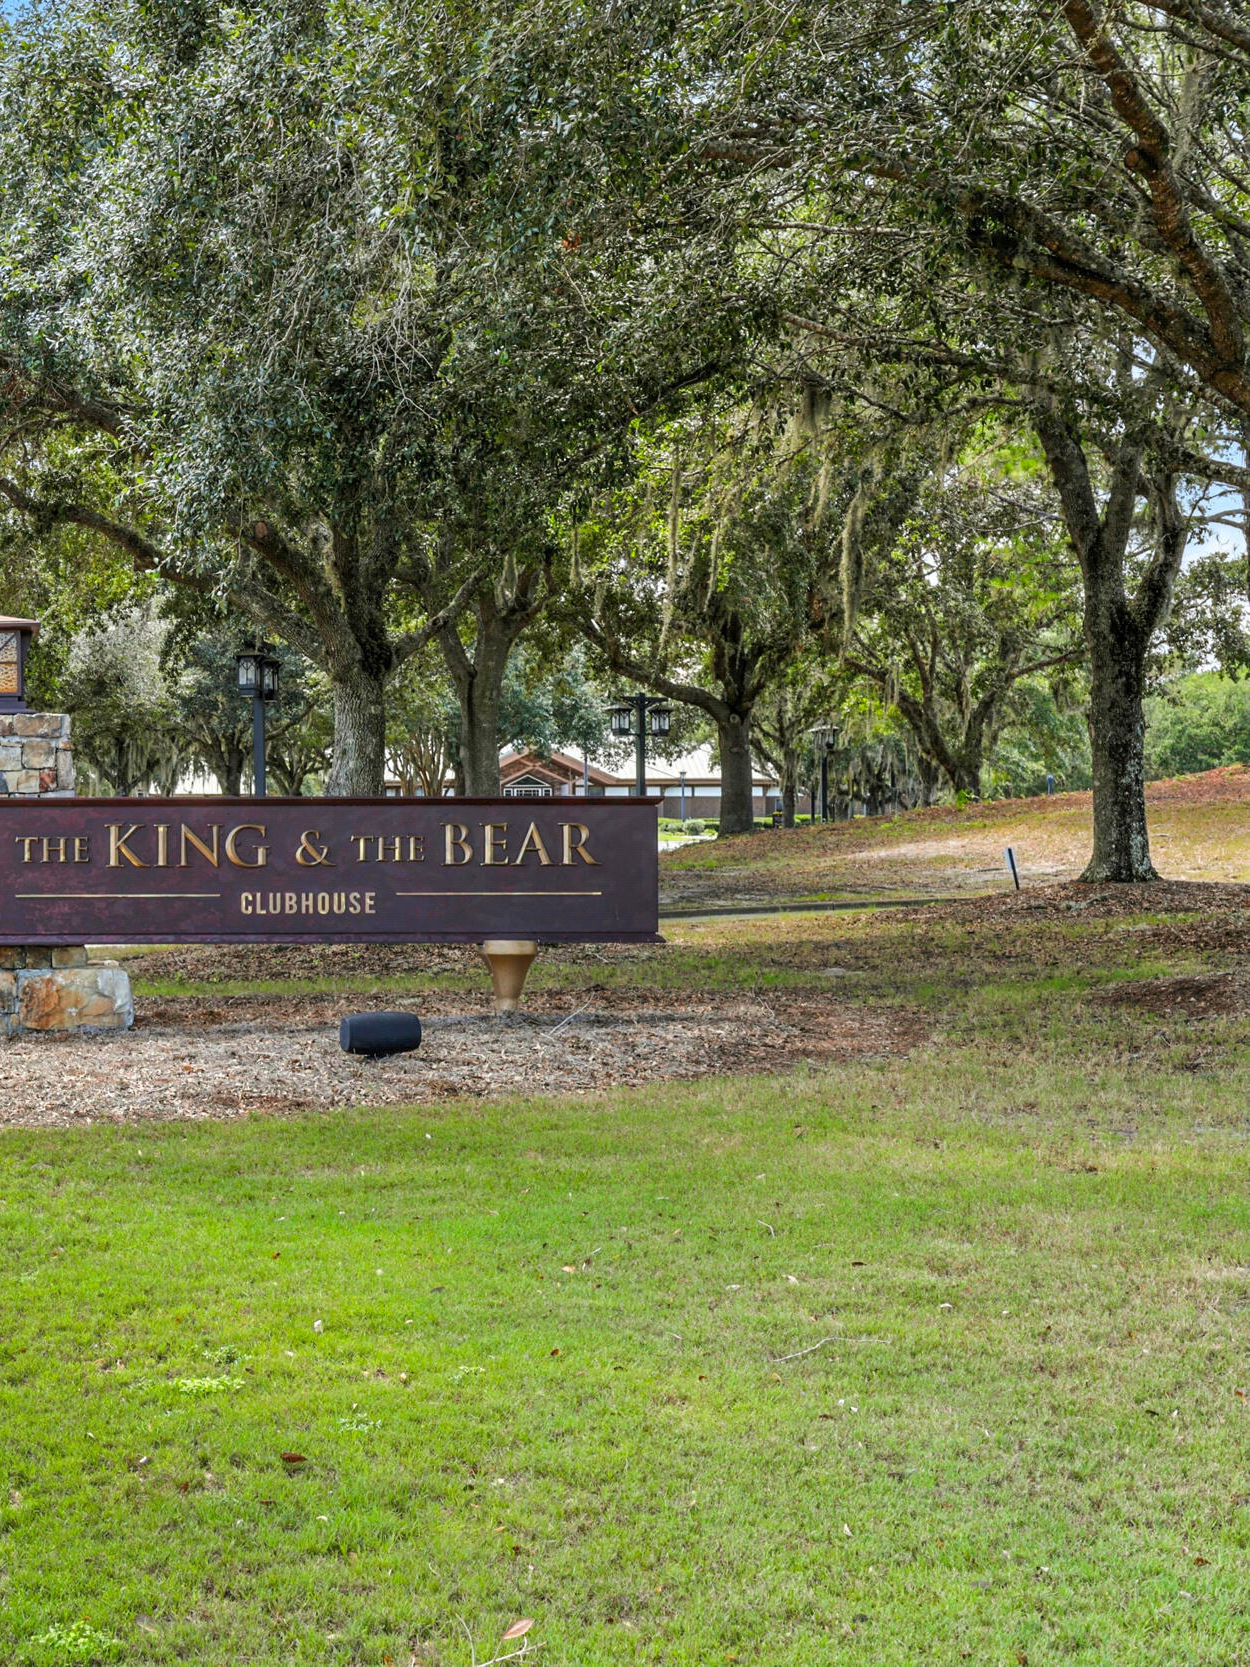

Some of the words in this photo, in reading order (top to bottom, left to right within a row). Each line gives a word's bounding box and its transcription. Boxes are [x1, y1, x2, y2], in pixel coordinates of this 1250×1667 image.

[15, 836, 90, 863] THE
[104, 823, 270, 868] KING
[295, 829, 337, 867] &
[350, 834, 425, 862] THE
[439, 821, 602, 866] BEAR
[240, 891, 376, 915] CLUBHOUSE
